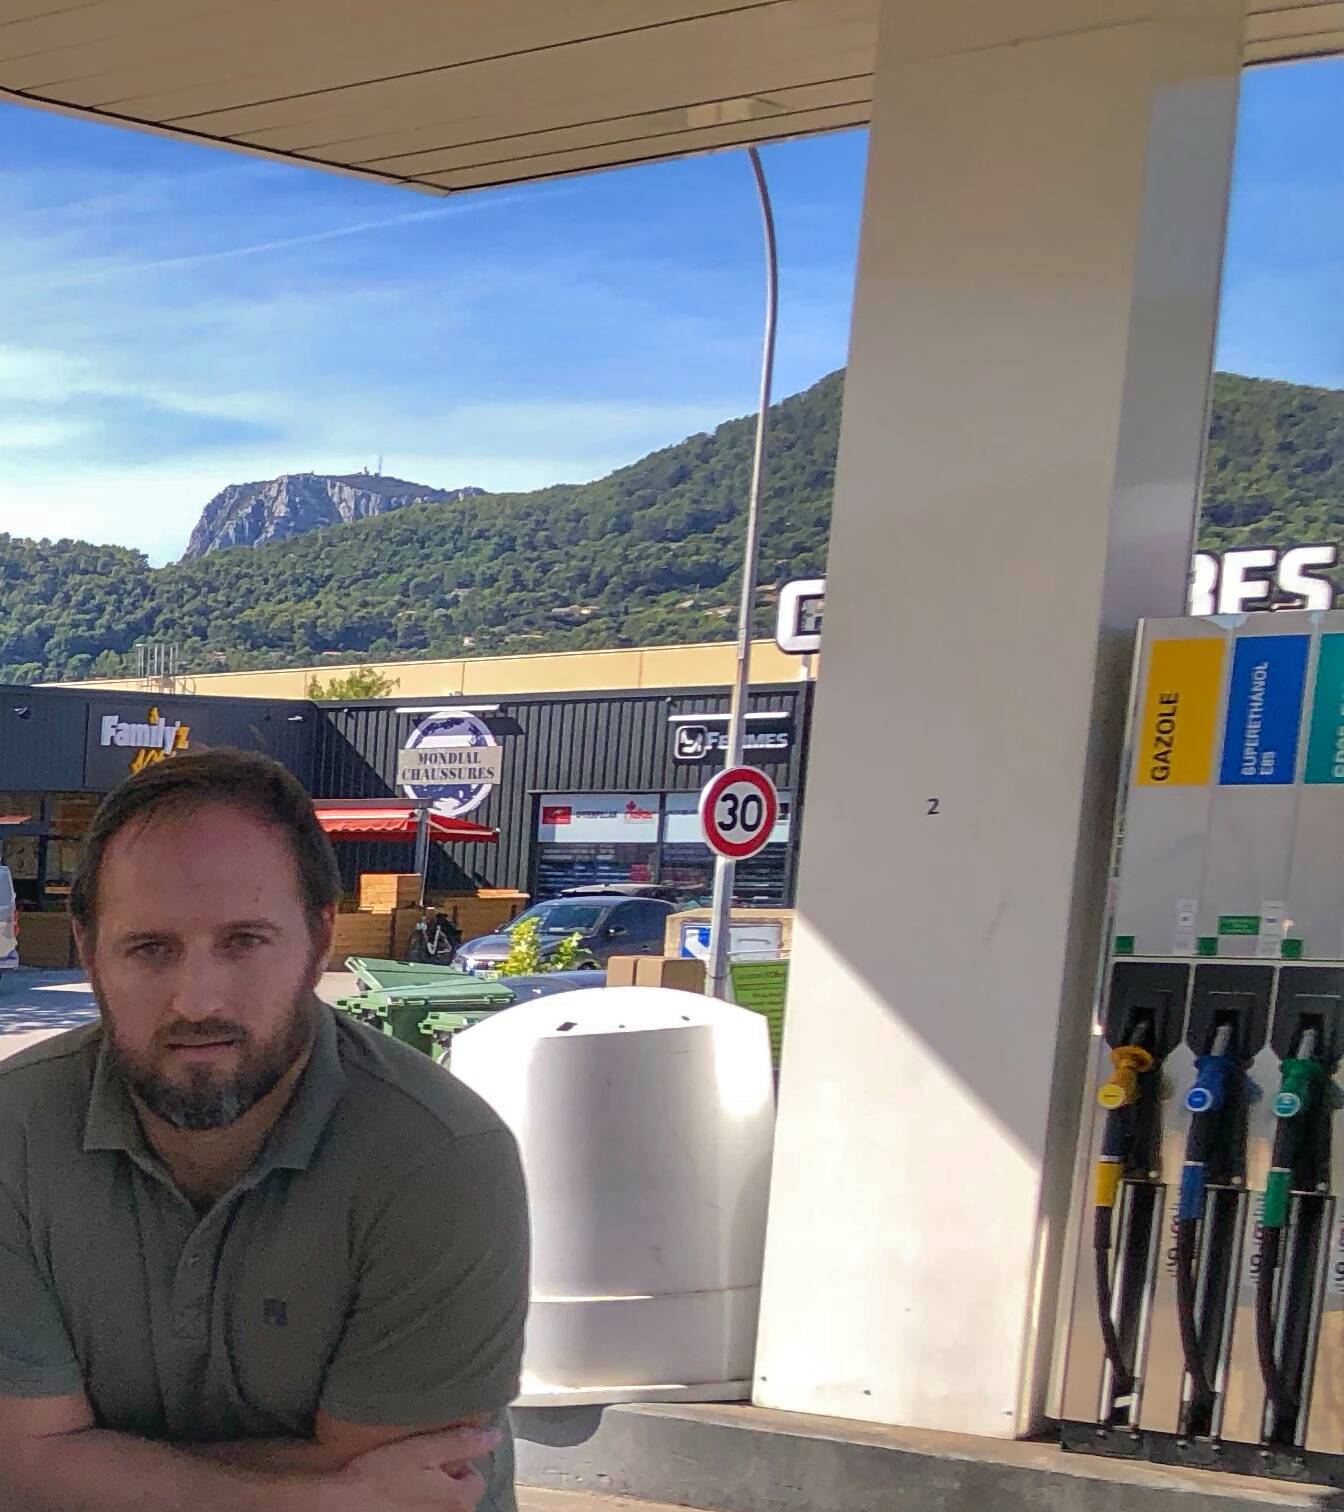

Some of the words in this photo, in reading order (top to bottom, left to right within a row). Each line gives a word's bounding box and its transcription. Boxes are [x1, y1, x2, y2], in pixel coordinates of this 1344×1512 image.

[706, 731, 789, 746] FEMES
[1150, 692, 1179, 782] GAZOLE
[417, 751, 482, 765] MONDIAL
[401, 766, 496, 781] CHAUSSURES
[717, 793, 763, 833] 30
[927, 798, 940, 816] 2
